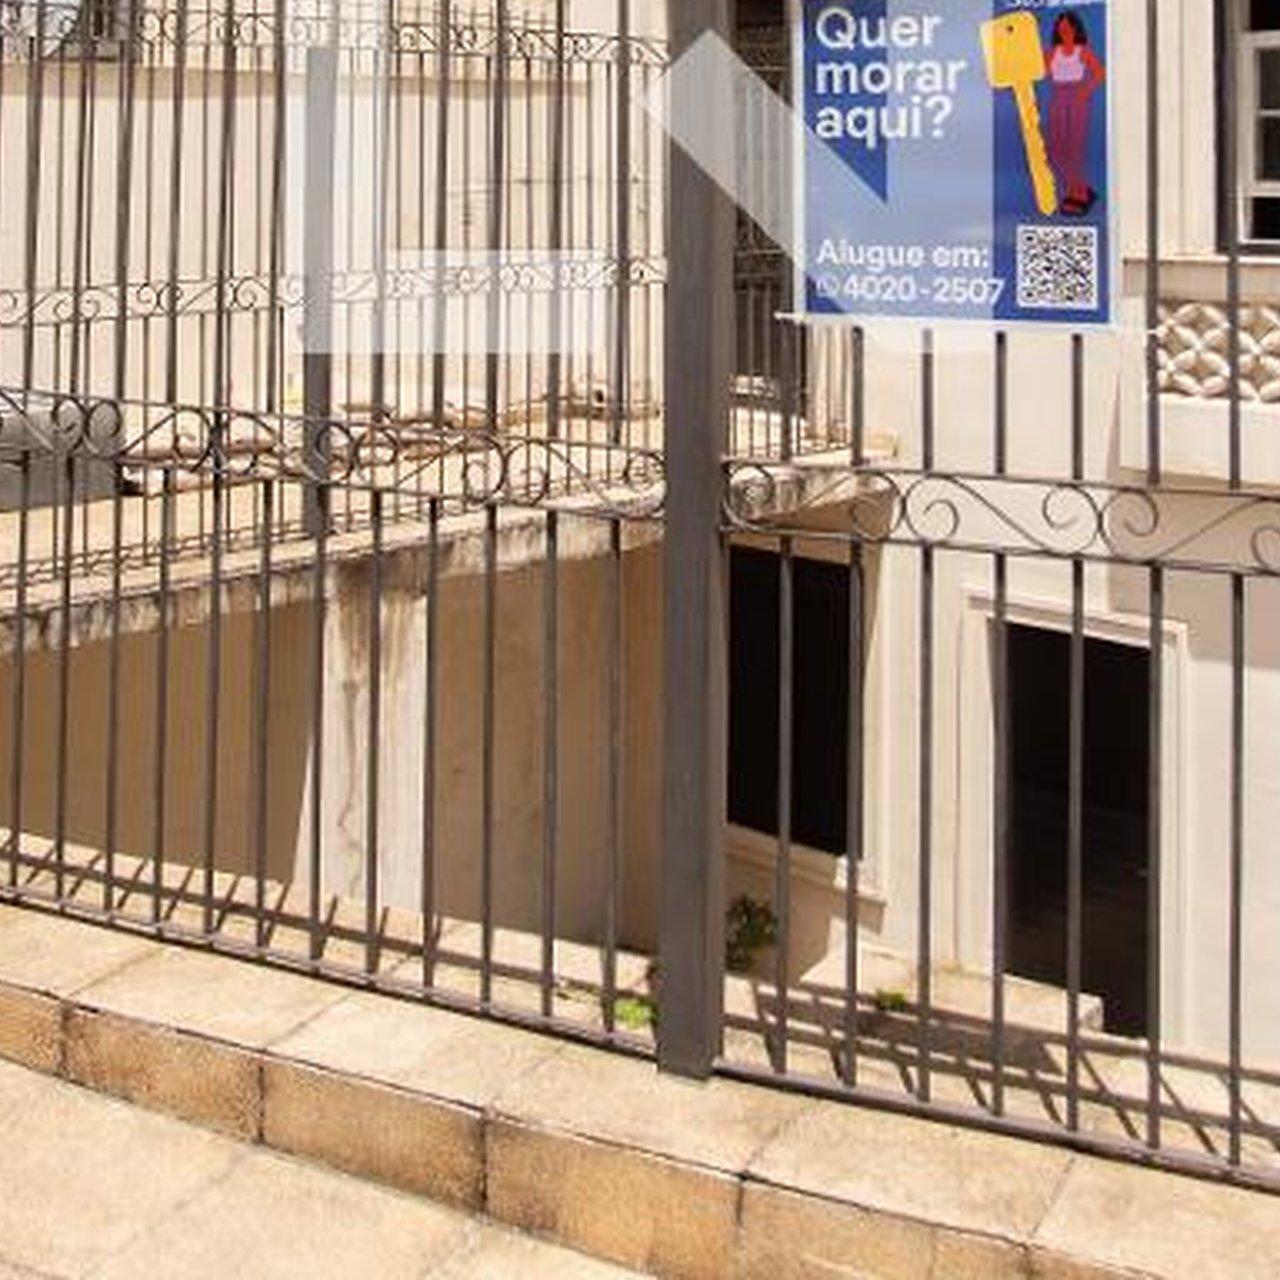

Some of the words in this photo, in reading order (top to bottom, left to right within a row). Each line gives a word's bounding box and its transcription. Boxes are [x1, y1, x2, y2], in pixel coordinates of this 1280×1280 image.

[816, 7, 942, 50] Quer
[816, 60, 967, 94] morar
[816, 95, 952, 149] aqui?
[818, 239, 924, 270] Alugue
[932, 245, 990, 268] em:
